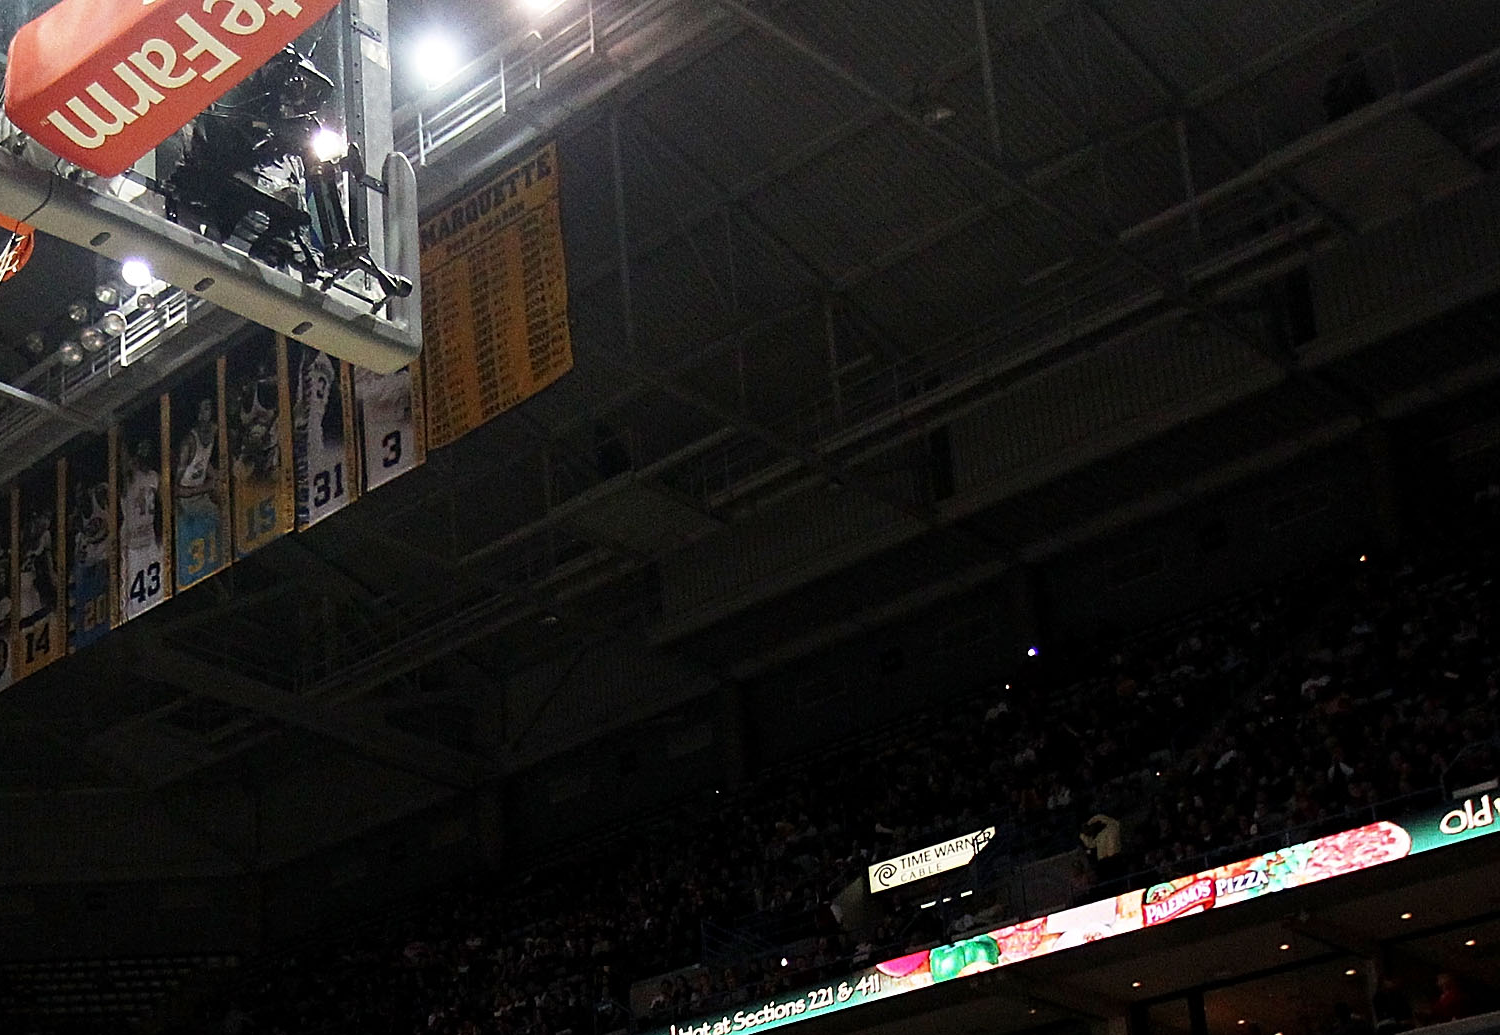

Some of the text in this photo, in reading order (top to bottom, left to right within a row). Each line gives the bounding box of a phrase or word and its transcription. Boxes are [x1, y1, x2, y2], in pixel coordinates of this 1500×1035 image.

[382, 430, 402, 467] 3
[313, 463, 343, 507] 31
[130, 561, 161, 603] 43
[25, 623, 50, 665] 14
[1440, 794, 1495, 835] Old
[900, 849, 932, 870] TIME
[900, 863, 943, 883] CABLE
[1215, 870, 1269, 898] PIZZA
[732, 997, 805, 1031] Sections
[807, 986, 834, 1010] 221
[836, 981, 854, 999] &
[854, 973, 882, 996] 411
